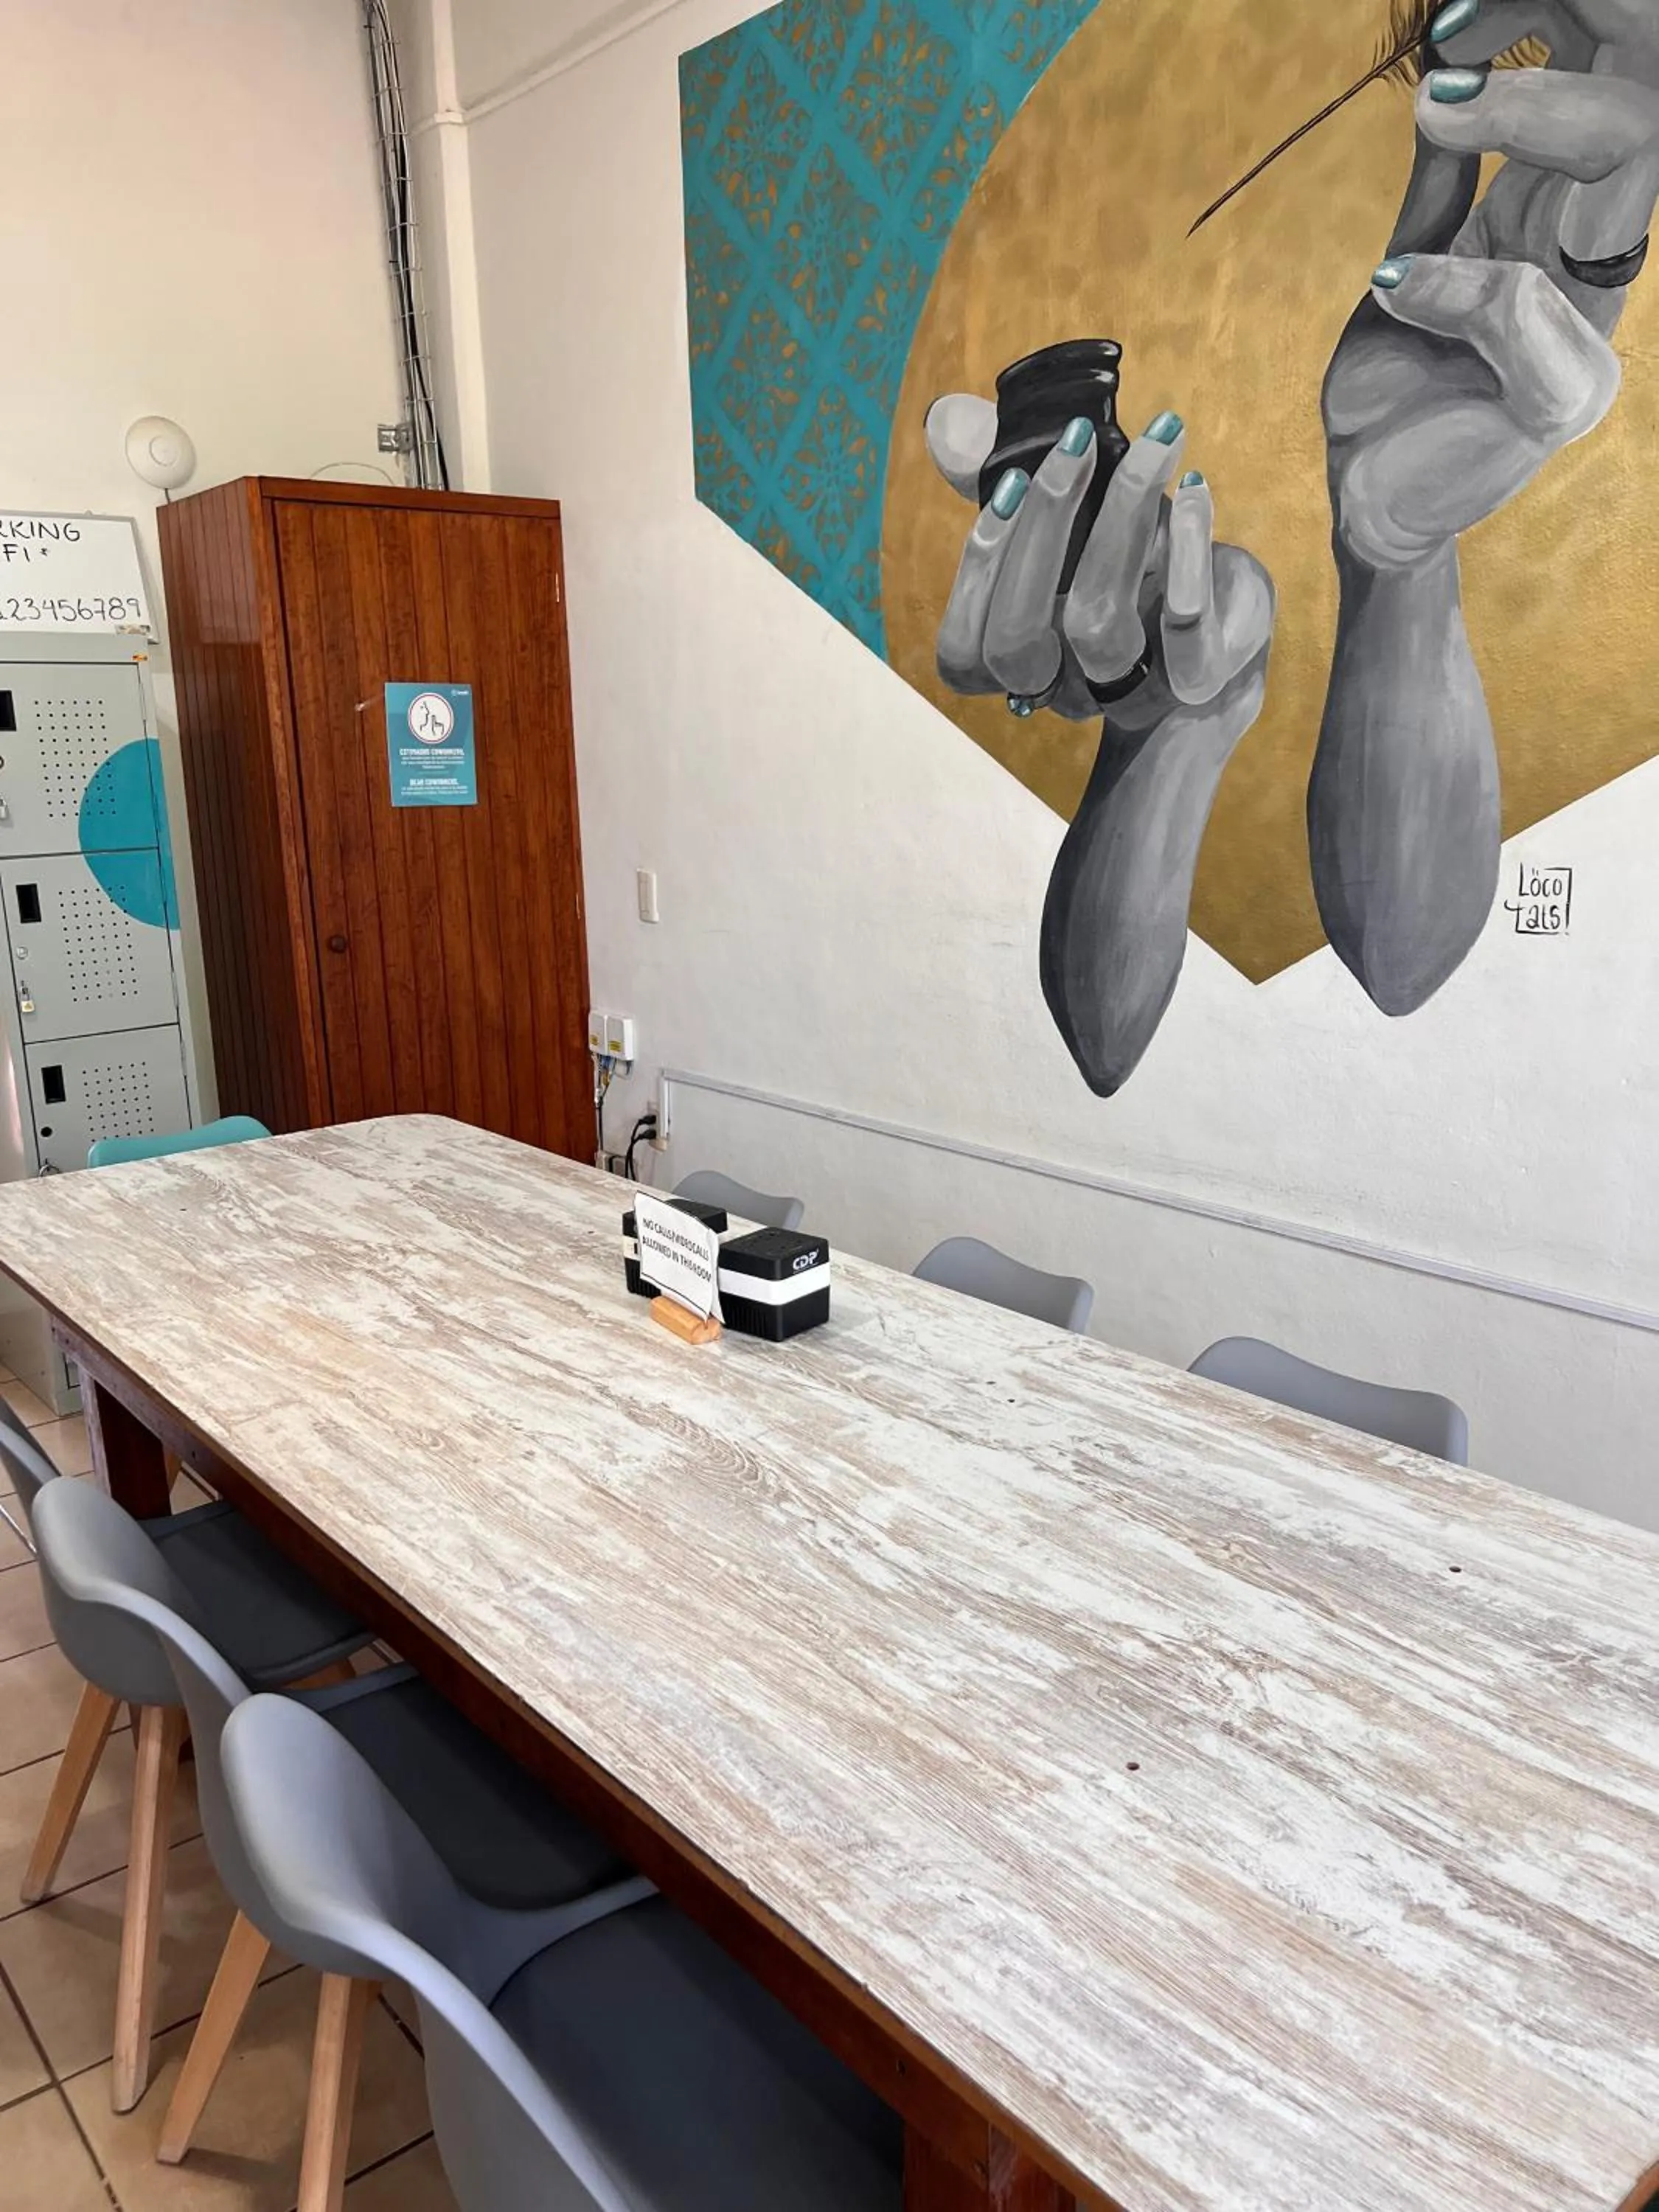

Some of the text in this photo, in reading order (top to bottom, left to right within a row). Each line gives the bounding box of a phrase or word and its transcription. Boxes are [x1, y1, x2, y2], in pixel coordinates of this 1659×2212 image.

[643, 1217, 654, 1231] NO
[642, 1235, 672, 1259] ALLOWED
[793, 1251, 818, 1270] CDP
